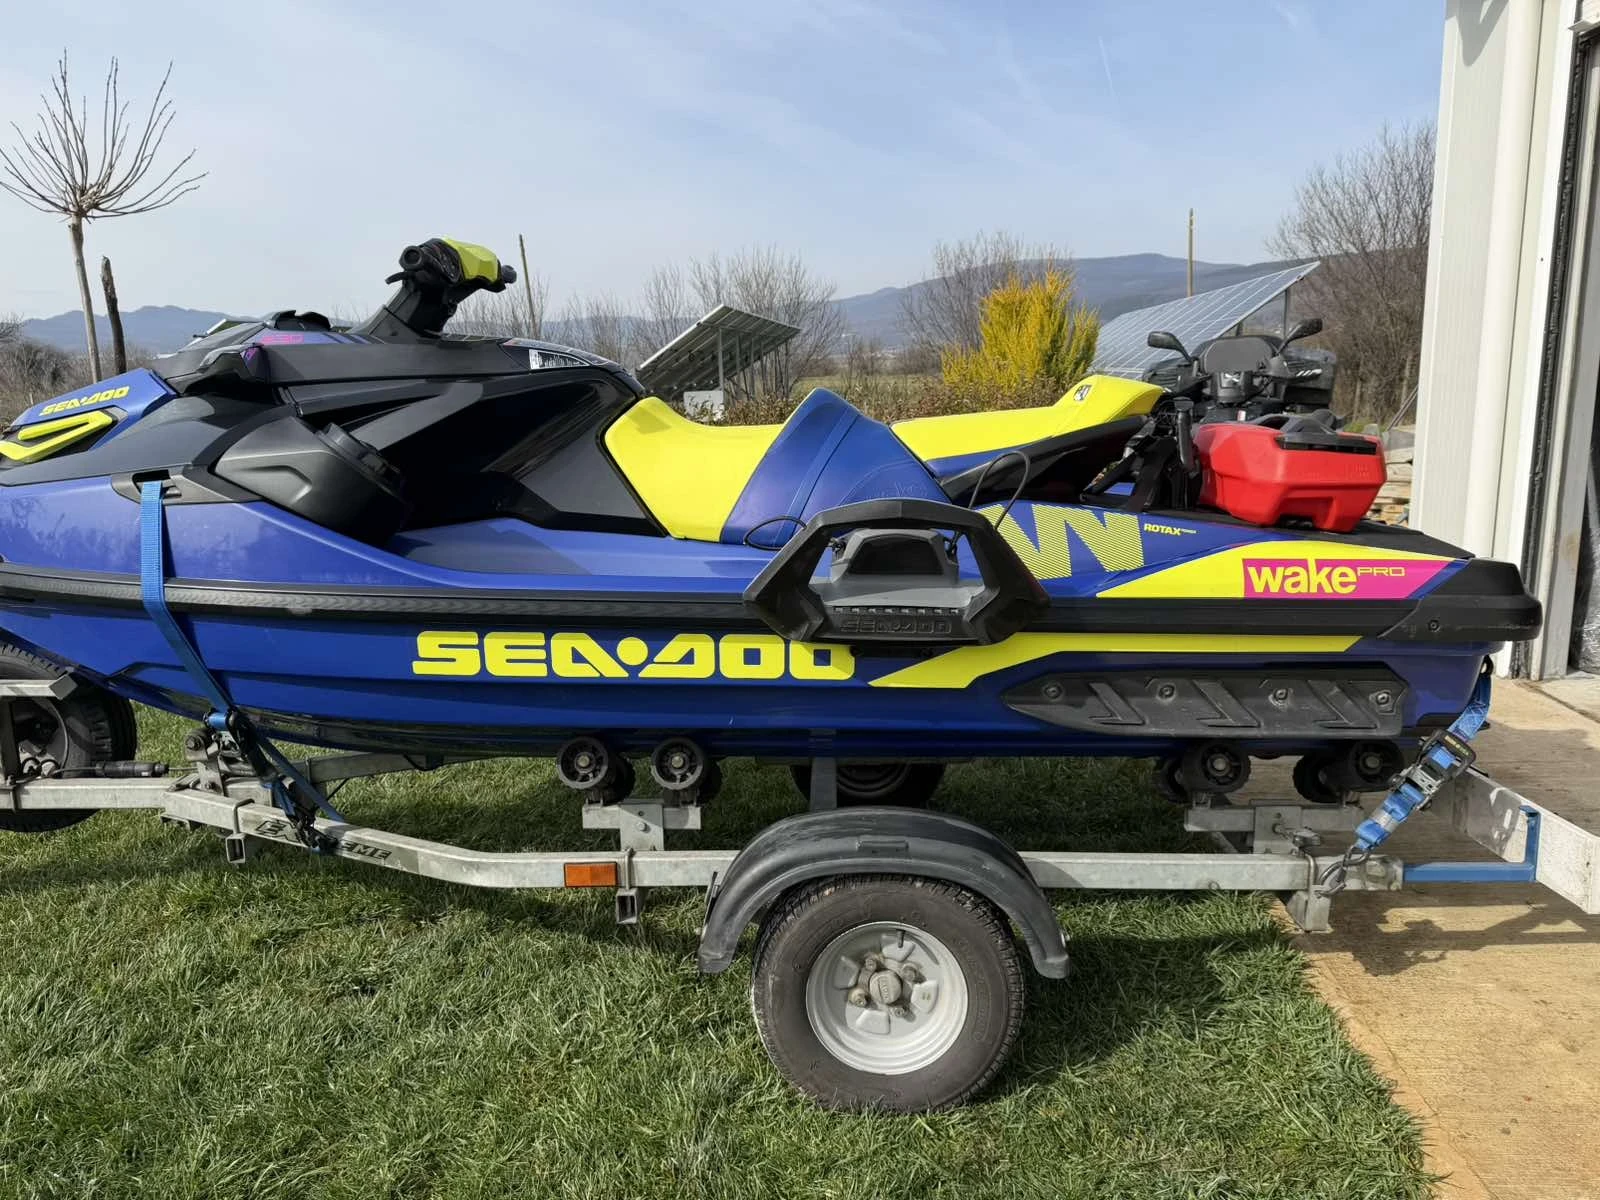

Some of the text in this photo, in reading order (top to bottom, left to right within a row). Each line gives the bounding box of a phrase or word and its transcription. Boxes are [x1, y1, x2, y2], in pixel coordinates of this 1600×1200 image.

[1143, 523, 1182, 536] ROTAX
[1247, 559, 1405, 594] wake PRO
